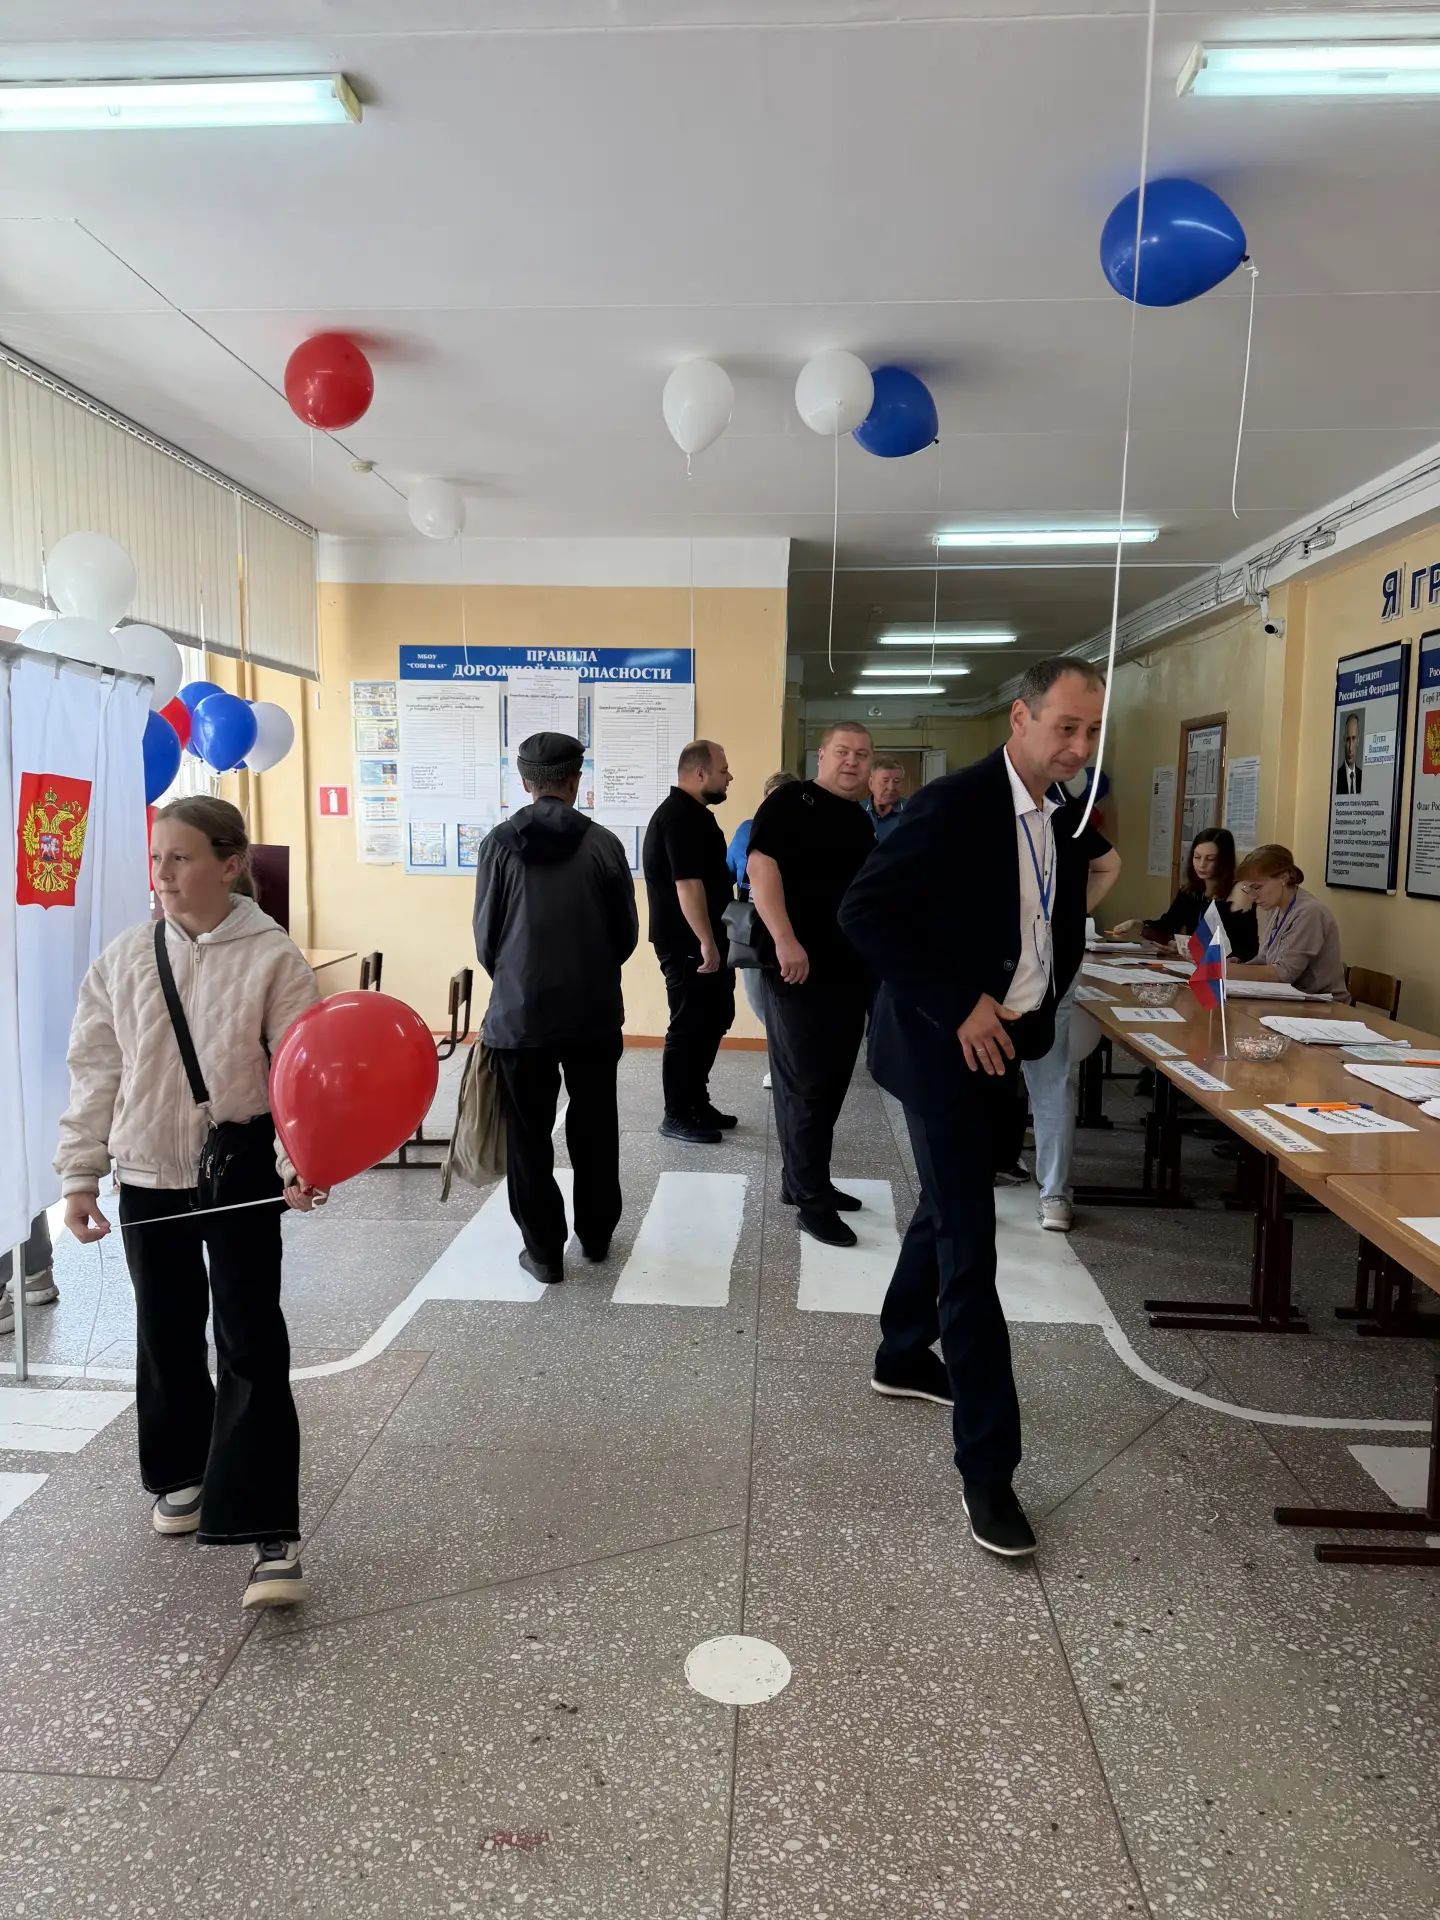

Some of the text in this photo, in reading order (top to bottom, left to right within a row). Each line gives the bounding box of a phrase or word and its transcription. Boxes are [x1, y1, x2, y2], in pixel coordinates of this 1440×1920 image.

[1381, 562, 1440, 620] Я ГР
[527, 650, 597, 662] ПРАВИЛА
[1354, 669, 1383, 685] Президент
[1338, 681, 1400, 702] Российской Федерации
